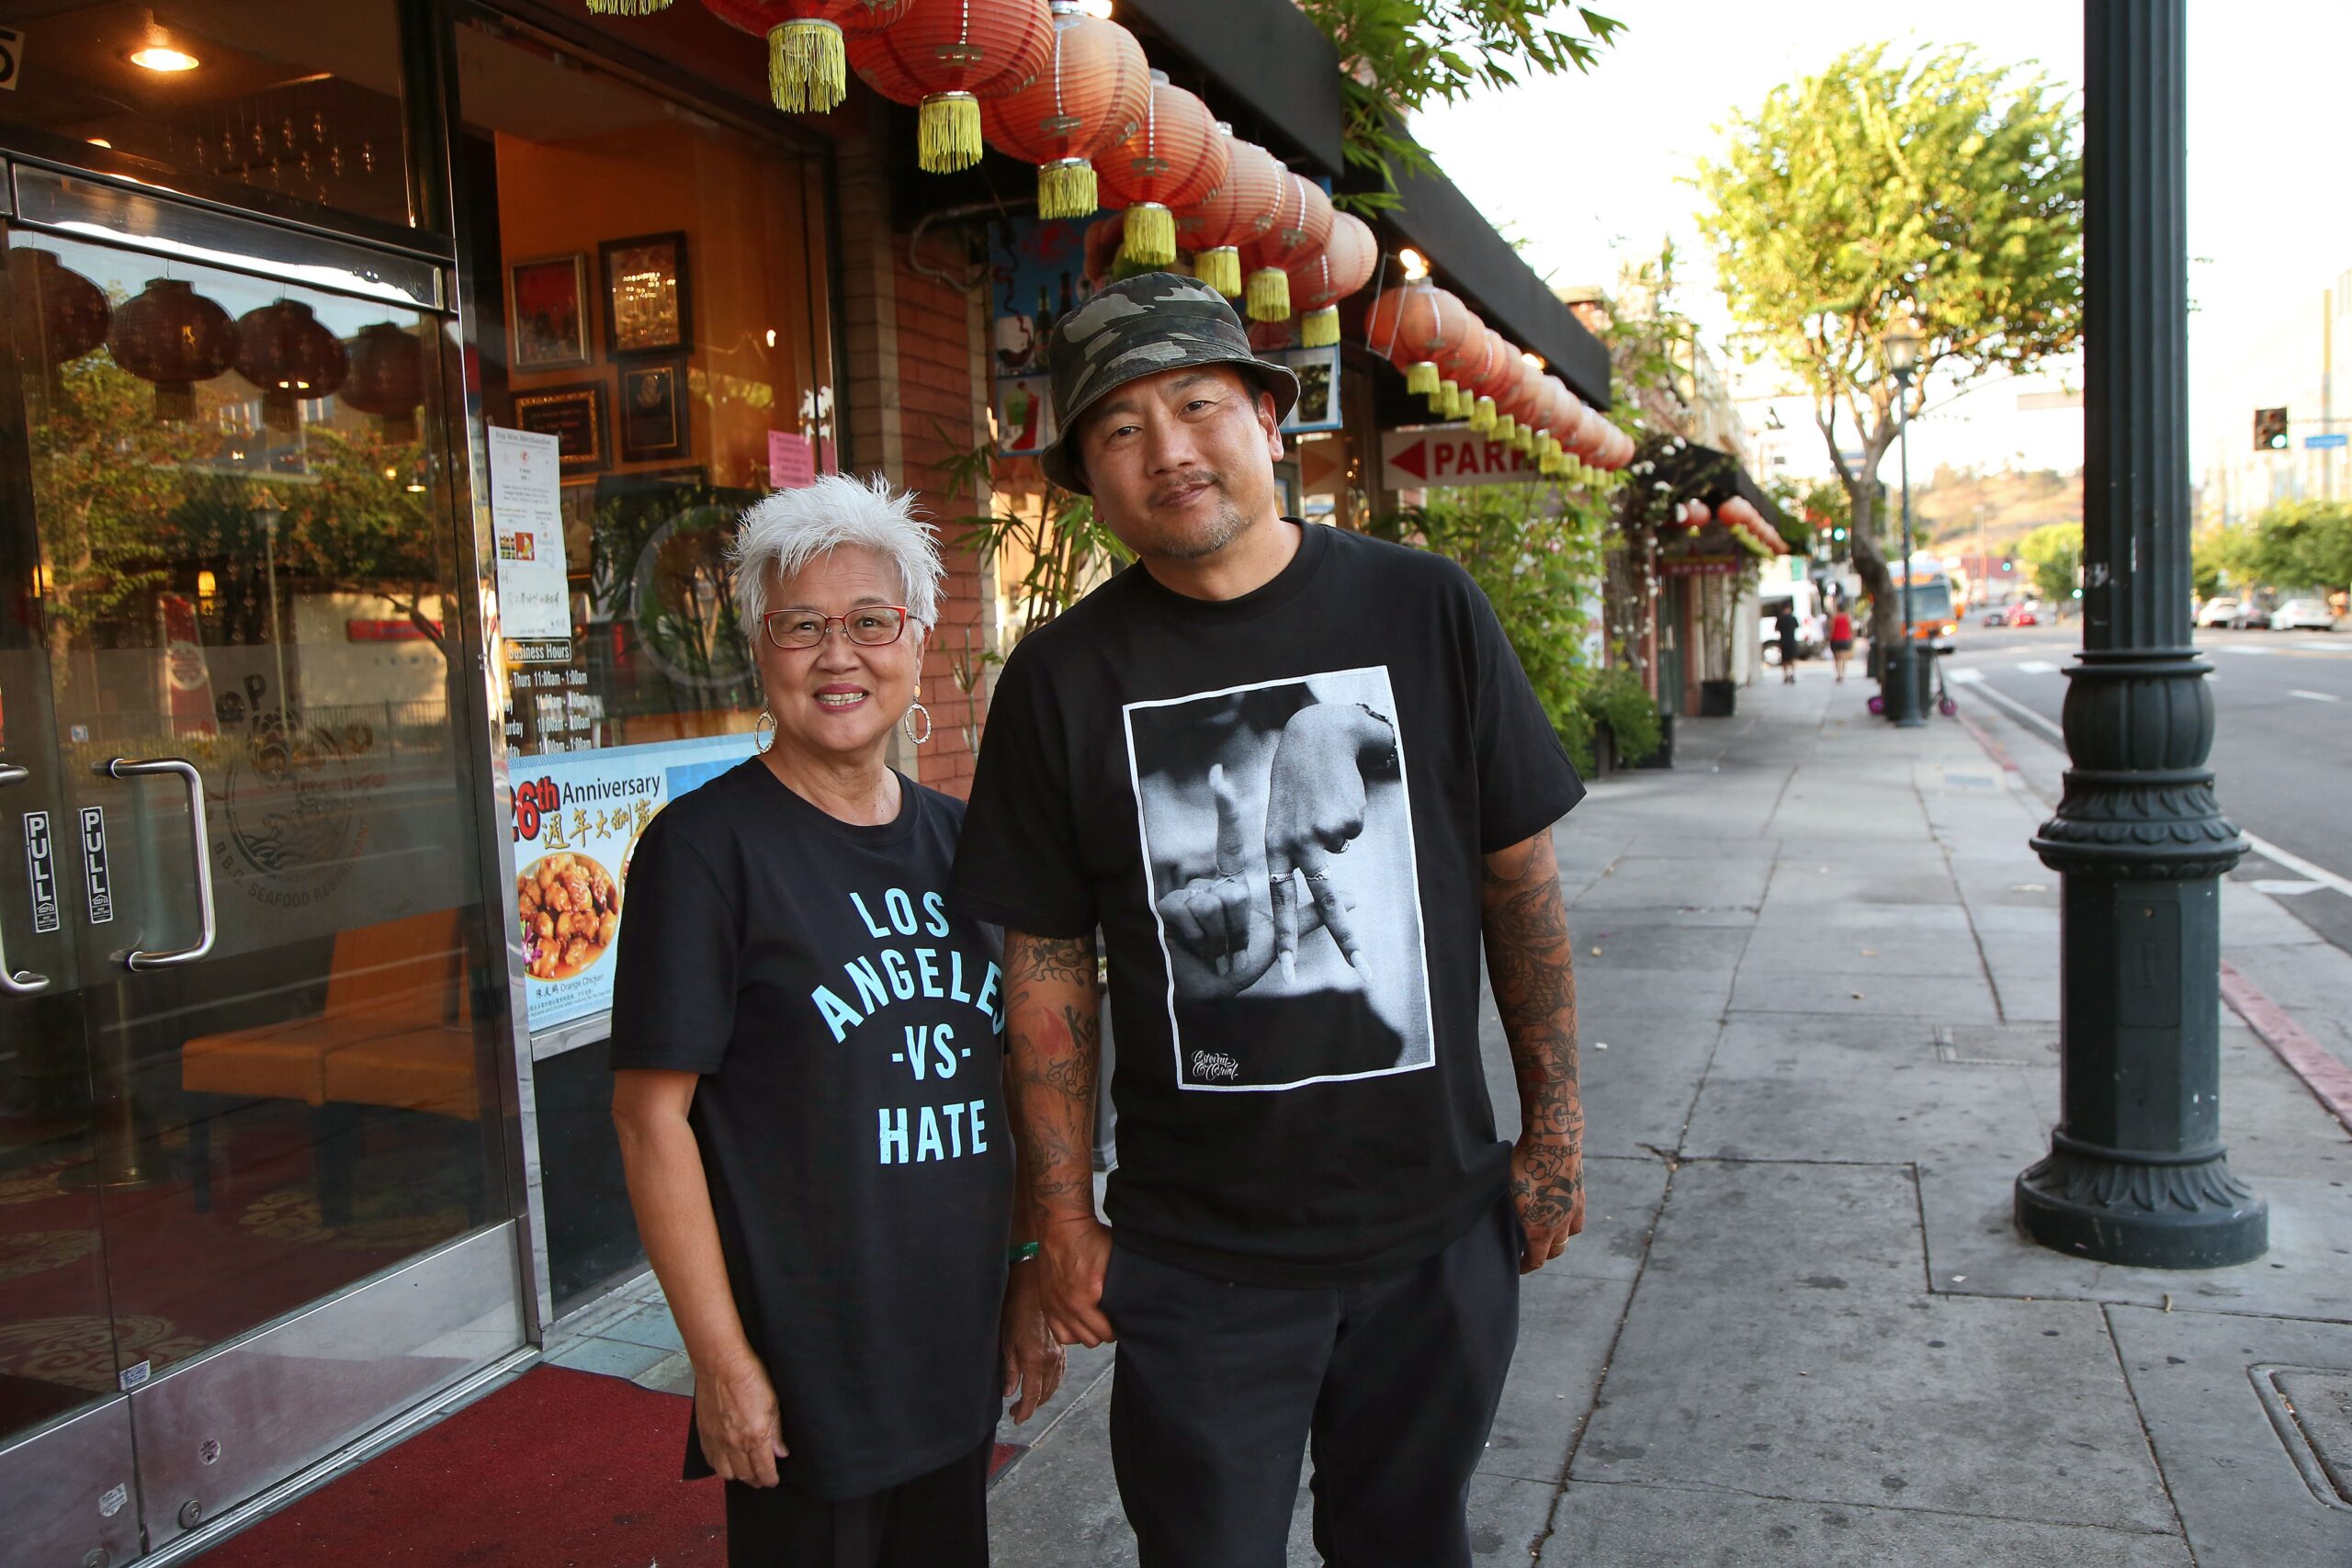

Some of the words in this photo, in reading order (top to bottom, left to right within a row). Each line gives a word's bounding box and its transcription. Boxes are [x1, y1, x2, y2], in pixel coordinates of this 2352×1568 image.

[1434, 440, 1536, 477] PAR
[508, 643, 545, 660] Business
[546, 642, 570, 660] Hours
[513, 671, 532, 688] Thurs
[534, 671, 561, 687] 11:00am
[565, 670, 588, 685] 1:00am
[562, 775, 661, 805] Anniversary
[28, 817, 52, 902] PULL
[85, 811, 106, 894] PULL
[247, 882, 311, 908] SEAFOOD
[849, 887, 950, 938] LOS
[560, 979, 582, 993] Orange
[582, 974, 605, 987] Chicken
[878, 1099, 988, 1165] HATE
